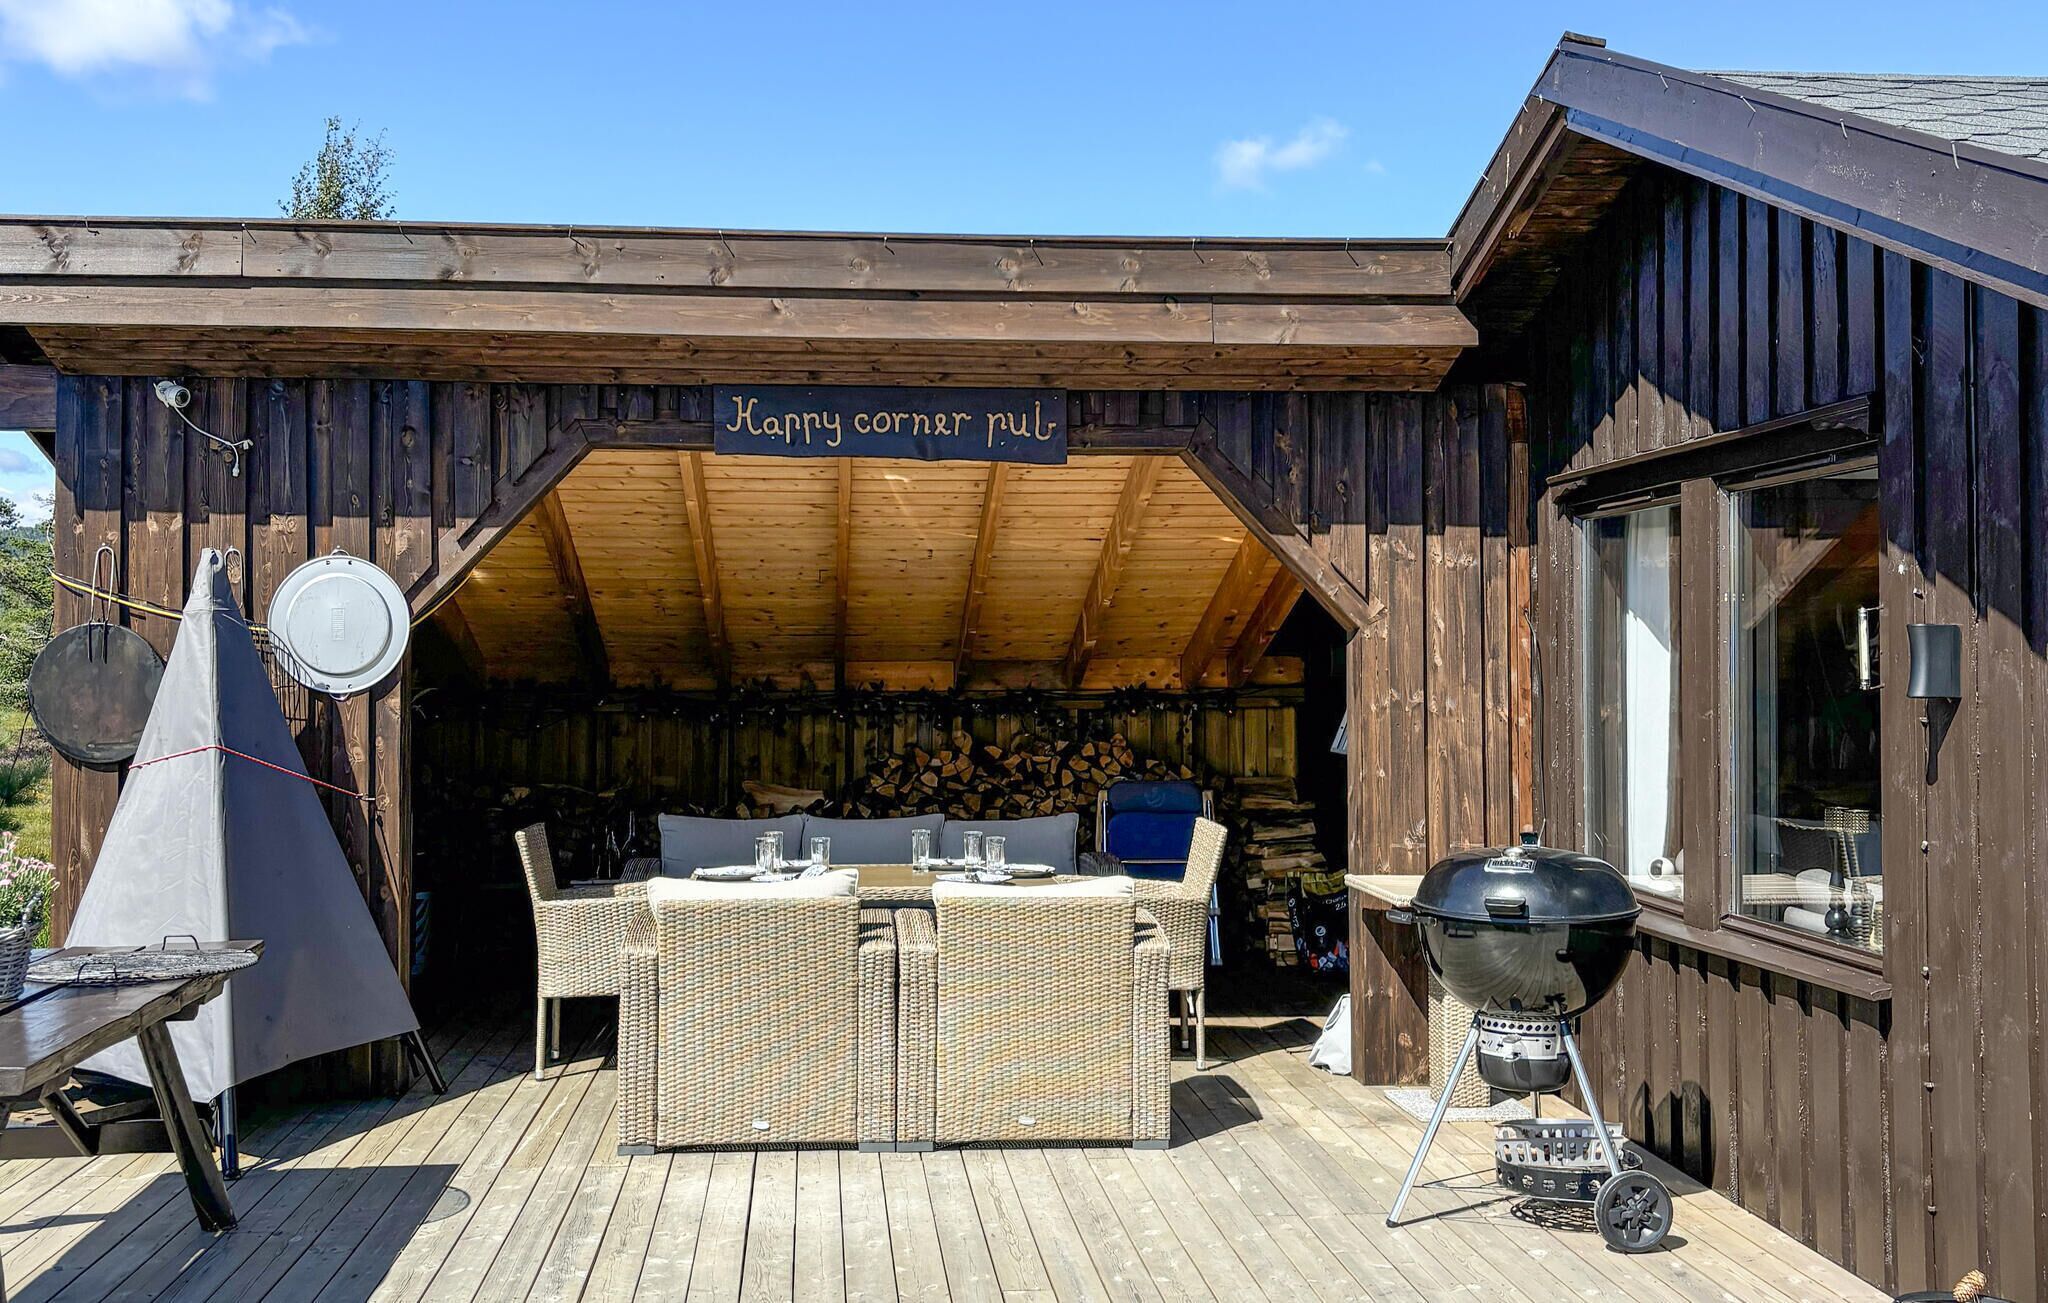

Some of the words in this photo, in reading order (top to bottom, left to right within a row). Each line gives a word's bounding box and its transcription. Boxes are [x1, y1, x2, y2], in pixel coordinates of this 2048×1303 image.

[726, 396, 842, 447] Happy
[854, 412, 972, 436] corner
[986, 400, 1057, 448] pub
